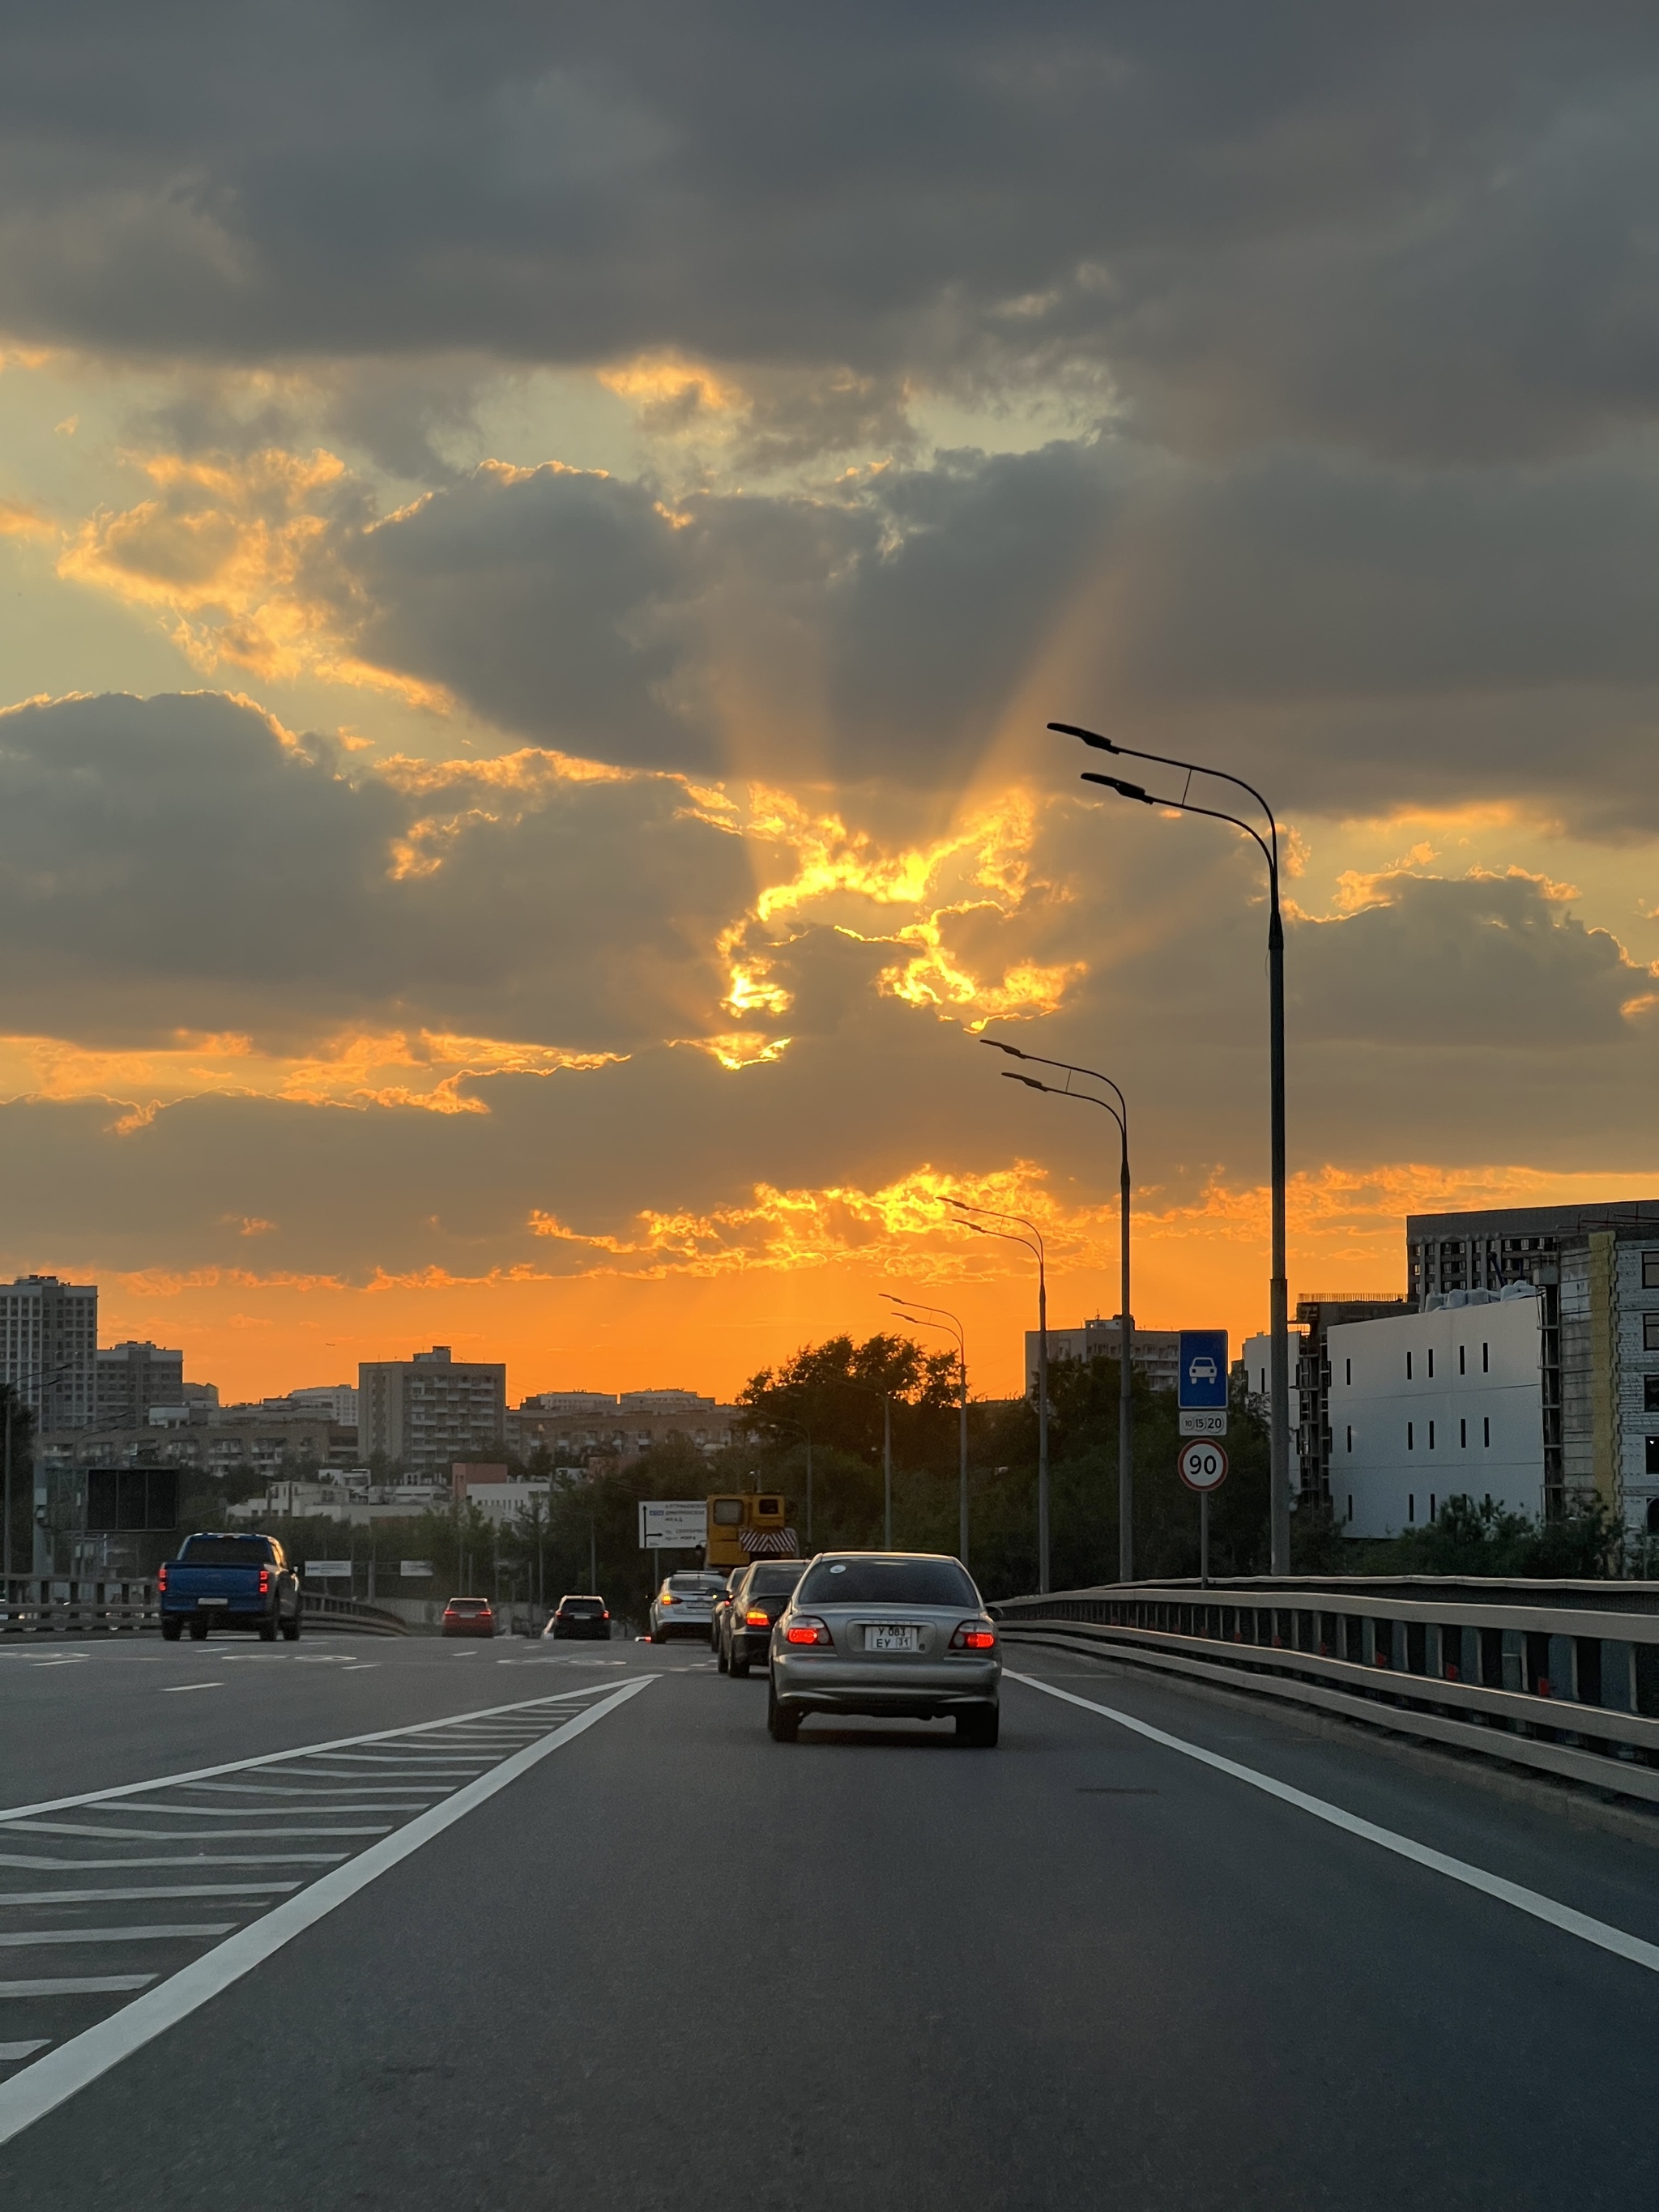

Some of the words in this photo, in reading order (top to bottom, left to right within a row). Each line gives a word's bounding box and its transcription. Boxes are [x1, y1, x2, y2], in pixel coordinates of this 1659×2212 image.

[1195, 1419, 1204, 1428] 15
[1207, 1418, 1222, 1429] 20
[1189, 1455, 1217, 1475] 90
[898, 1638, 908, 1646] 31
